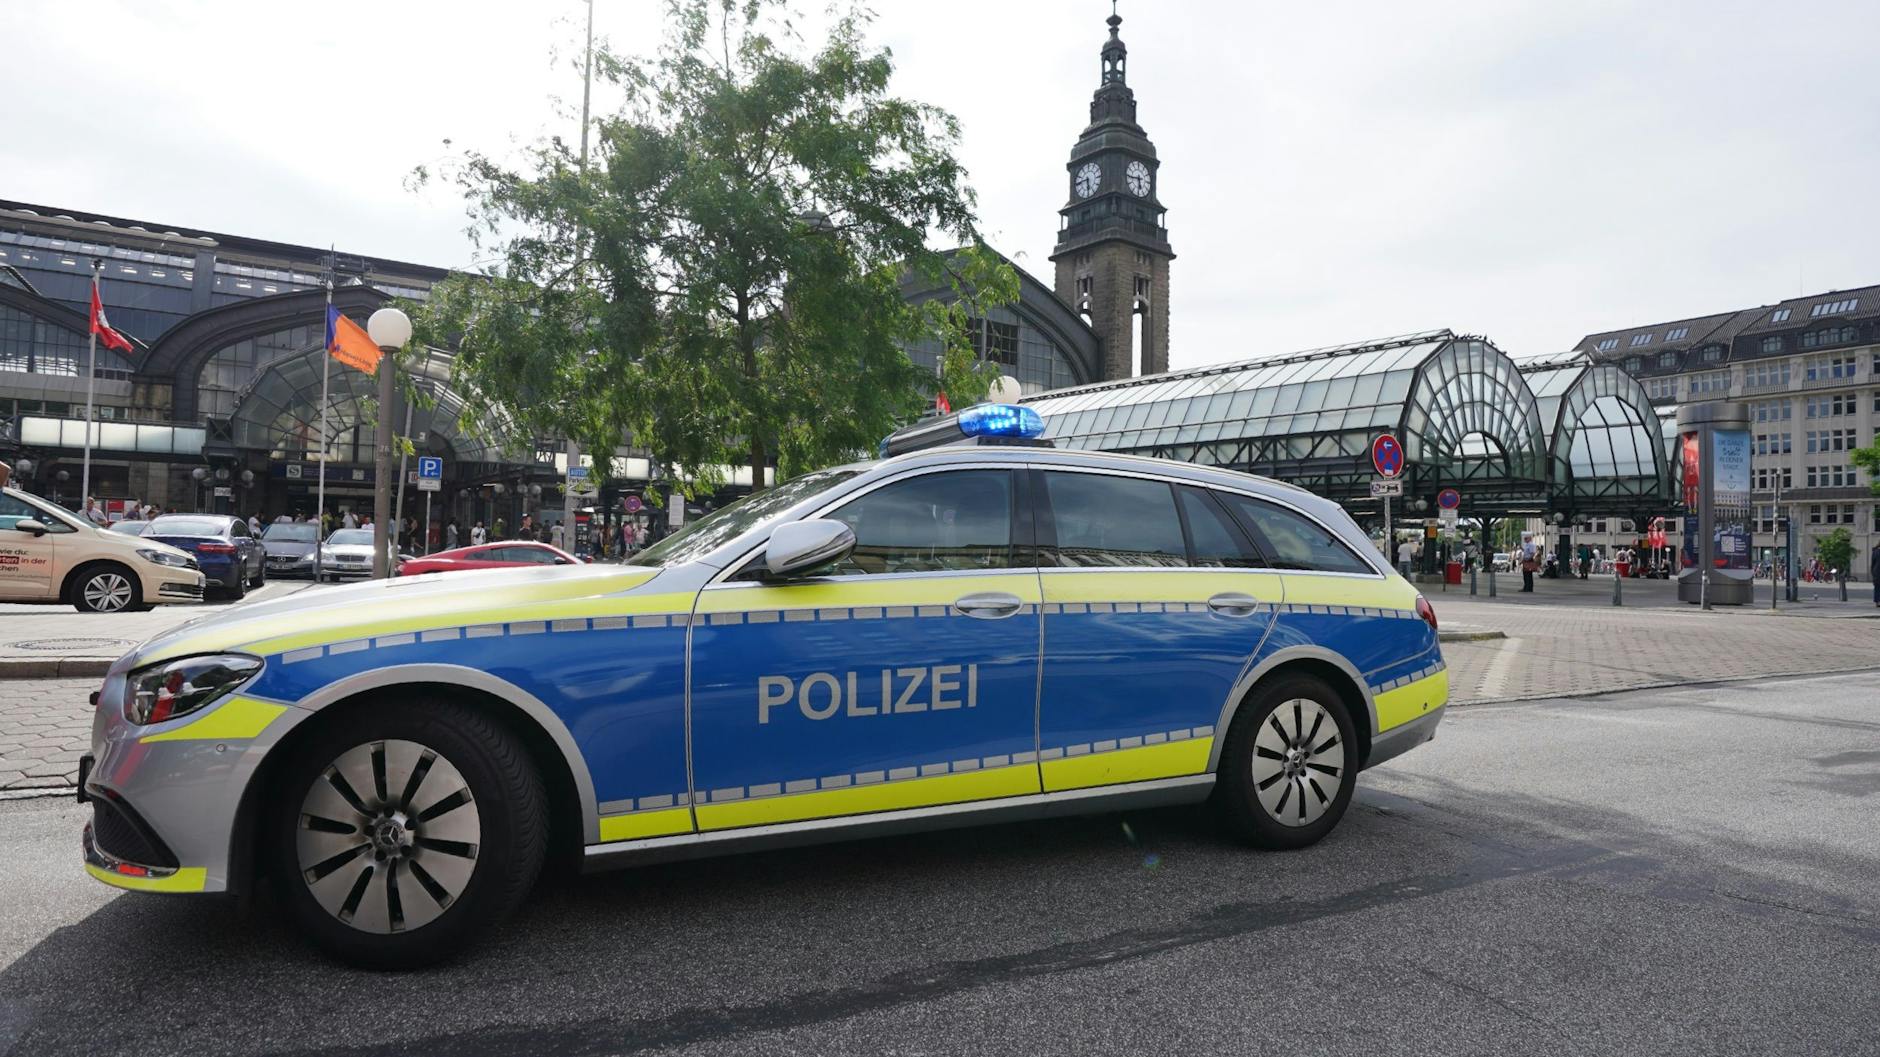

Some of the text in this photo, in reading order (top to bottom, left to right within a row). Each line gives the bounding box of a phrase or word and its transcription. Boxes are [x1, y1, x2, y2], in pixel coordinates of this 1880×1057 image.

[424, 460, 437, 476] P
[31, 557, 47, 565] der
[758, 663, 978, 724] POLIZEI
